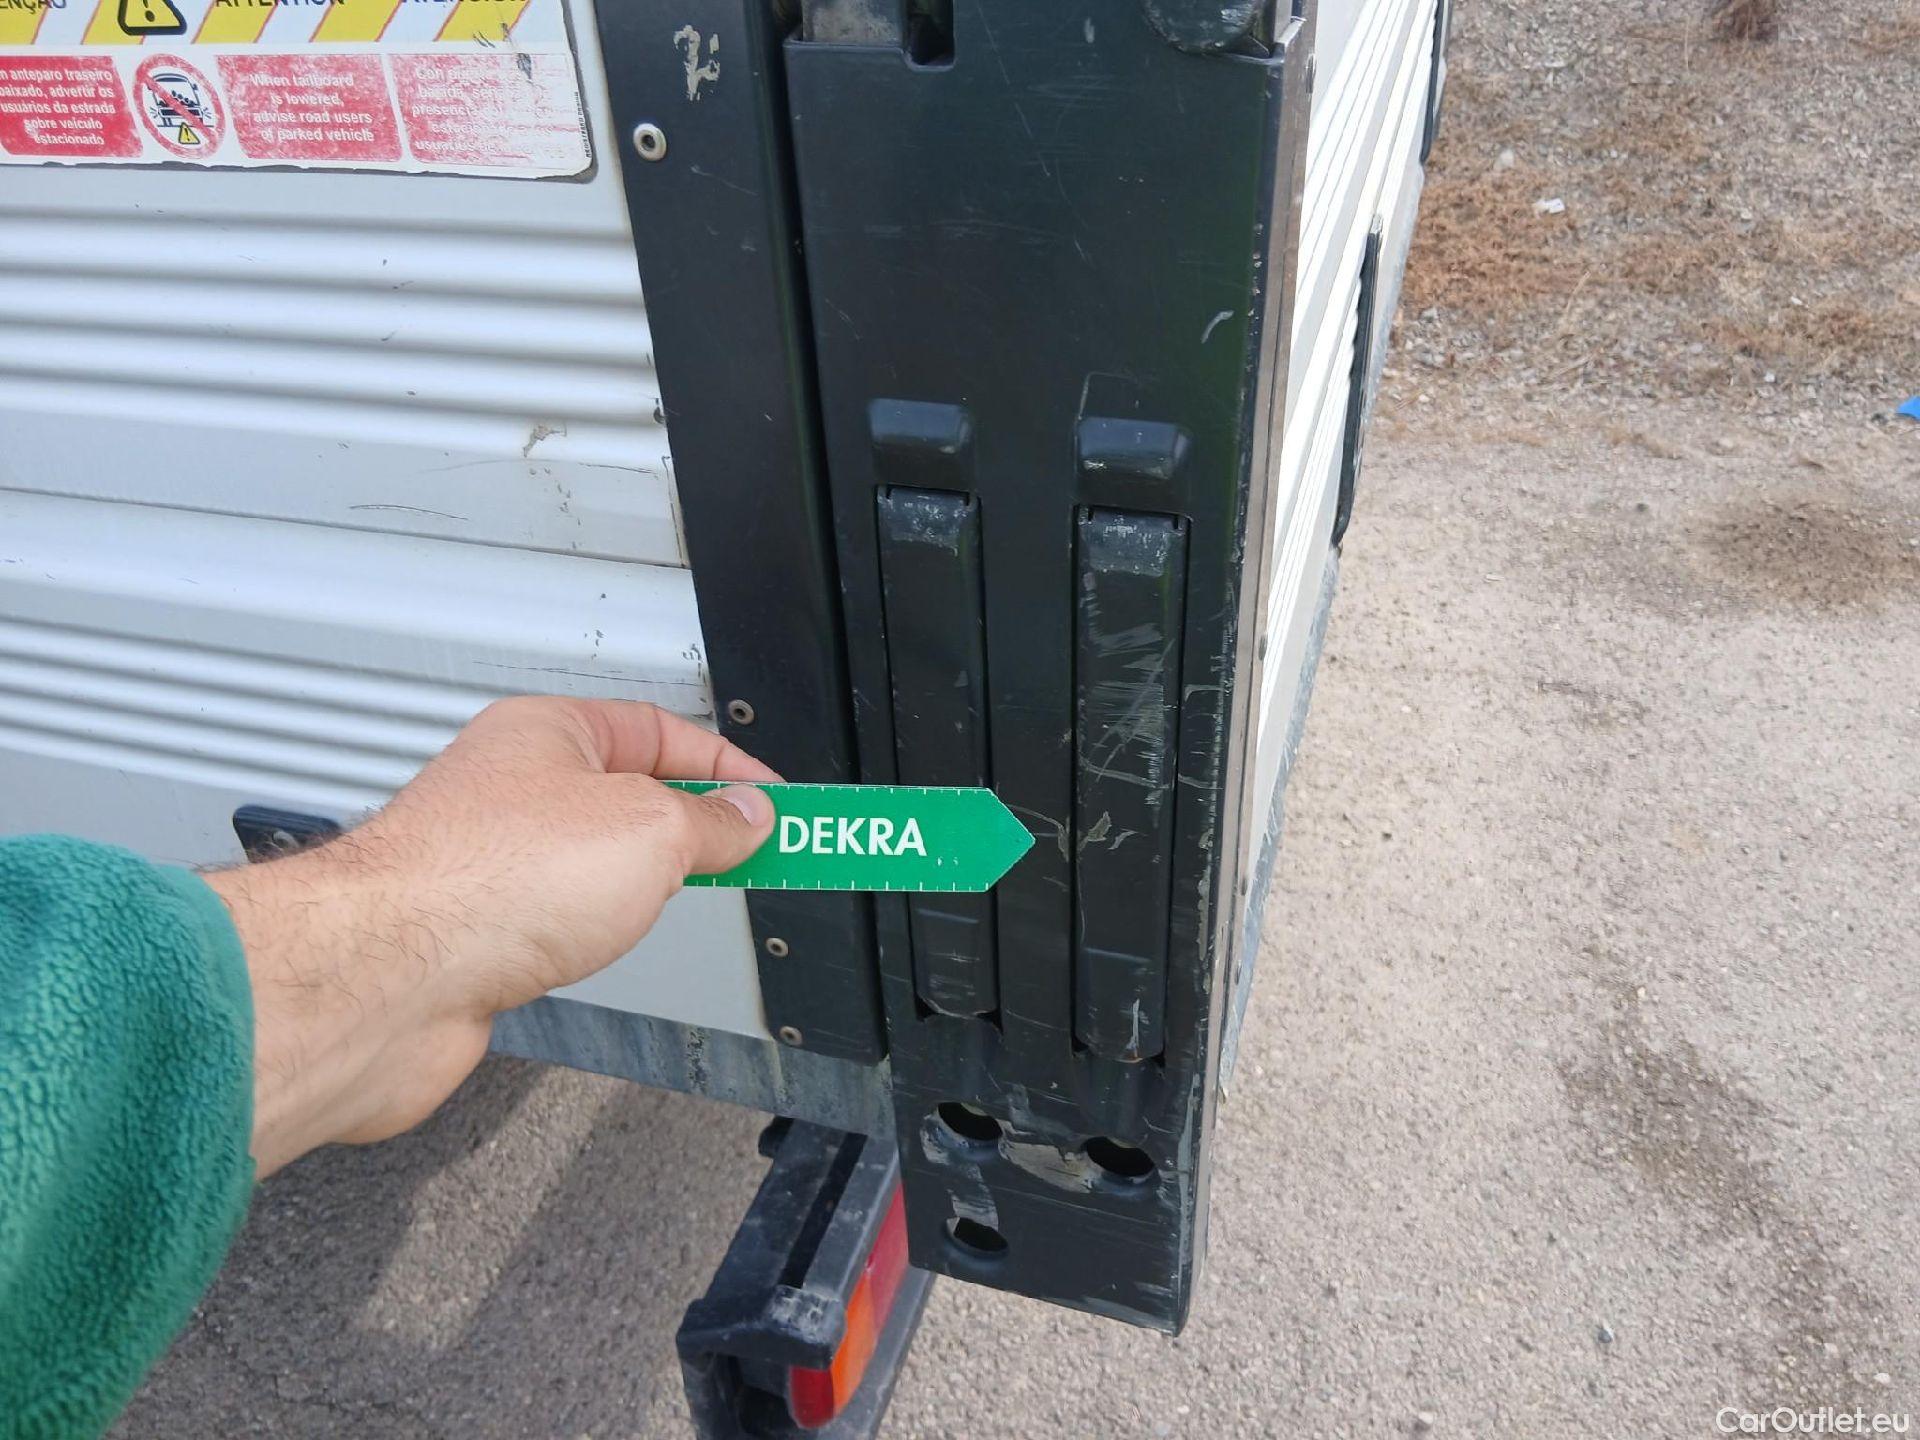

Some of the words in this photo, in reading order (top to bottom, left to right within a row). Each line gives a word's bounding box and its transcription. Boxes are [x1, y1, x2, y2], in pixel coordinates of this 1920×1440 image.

[9, 68, 62, 83] anteparo
[64, 68, 113, 81] traseiro
[249, 74, 291, 86] When
[292, 73, 354, 87] tailboard
[49, 84, 96, 98] advertir
[53, 101, 69, 113] da
[70, 101, 116, 114] estrada
[24, 117, 57, 129] sobre
[253, 110, 296, 123] advise
[299, 110, 330, 123] road
[333, 111, 374, 123] users
[34, 133, 105, 145] estacionado
[277, 127, 324, 142] parked
[325, 126, 375, 141] vehicle
[778, 815, 928, 857] DEKRA
